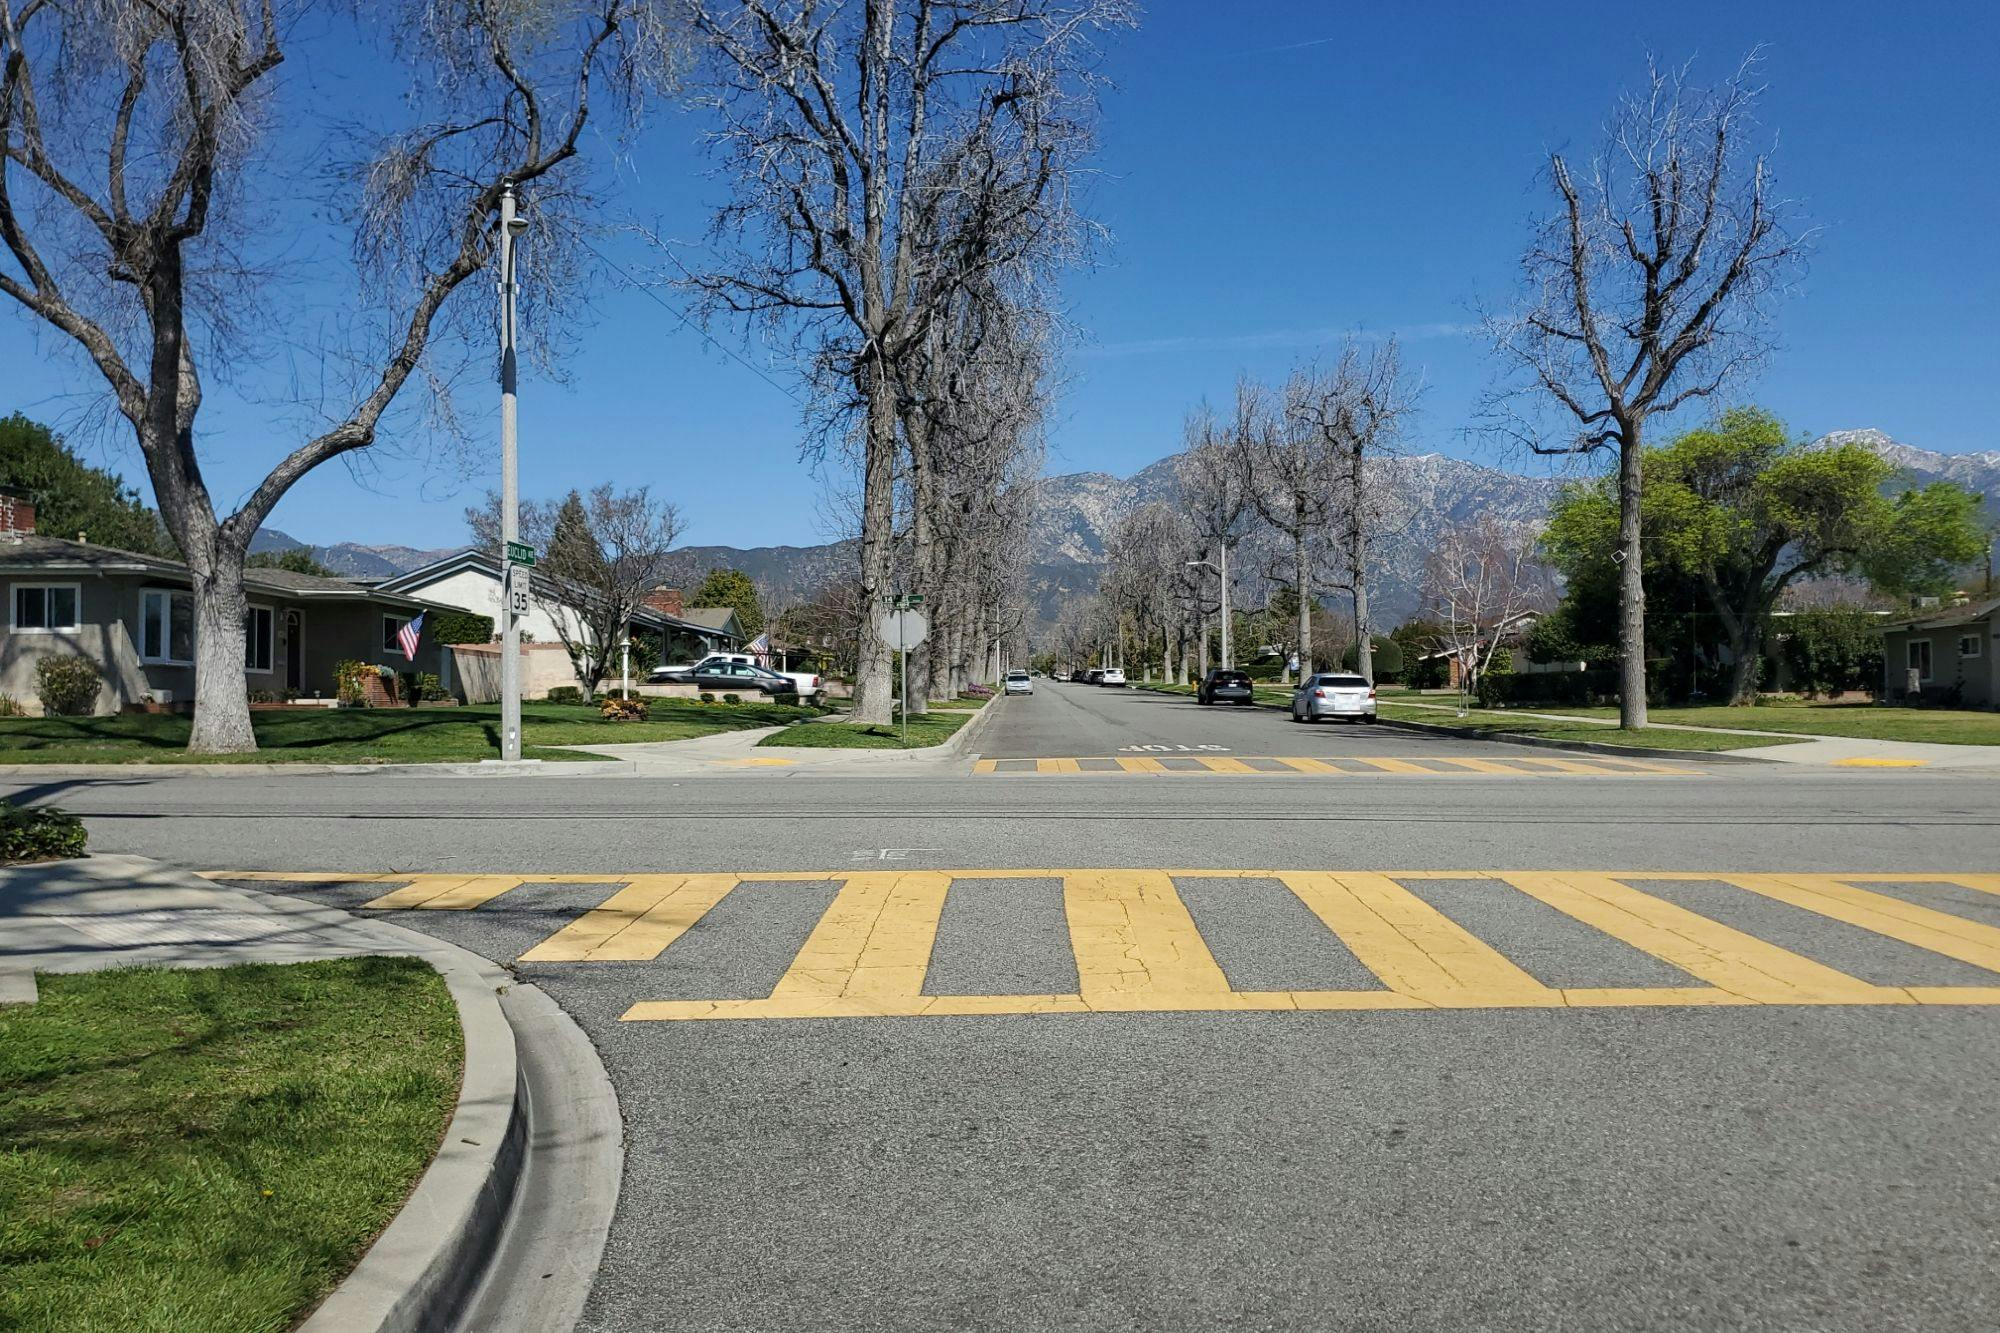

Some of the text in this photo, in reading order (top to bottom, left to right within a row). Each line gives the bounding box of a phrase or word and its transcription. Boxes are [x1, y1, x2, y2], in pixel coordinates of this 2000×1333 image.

[508, 545, 527, 560] EUCLID
[513, 568, 528, 579] SPEED
[515, 581, 527, 589] LIMIT
[514, 592, 527, 611] 35
[1118, 744, 1231, 752] STOP
